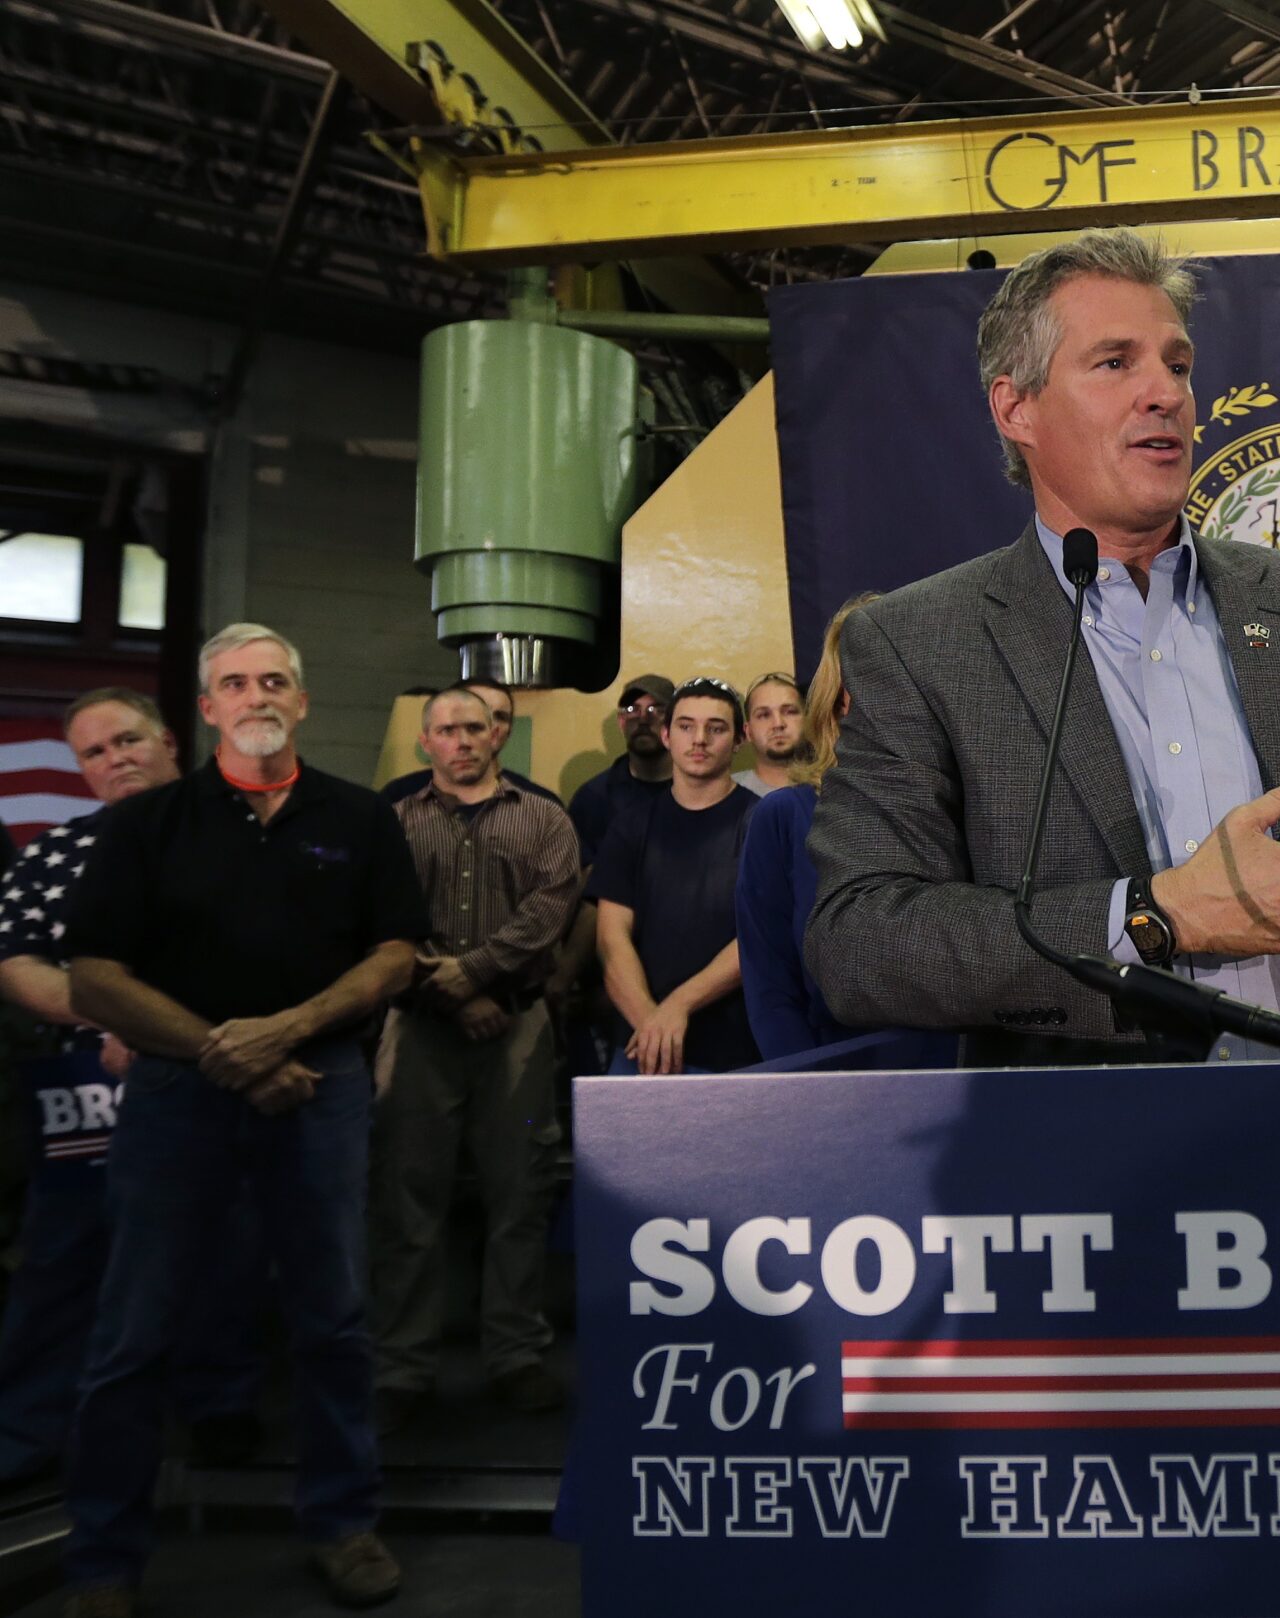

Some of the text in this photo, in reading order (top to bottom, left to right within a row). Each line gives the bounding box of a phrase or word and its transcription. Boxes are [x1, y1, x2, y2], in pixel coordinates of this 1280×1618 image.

[985, 132, 1136, 210] GMF
[1184, 488, 1214, 525] HE
[630, 1214, 1113, 1316] SCOTT
[632, 1342, 816, 1432] For
[632, 1456, 909, 1538] NEW
